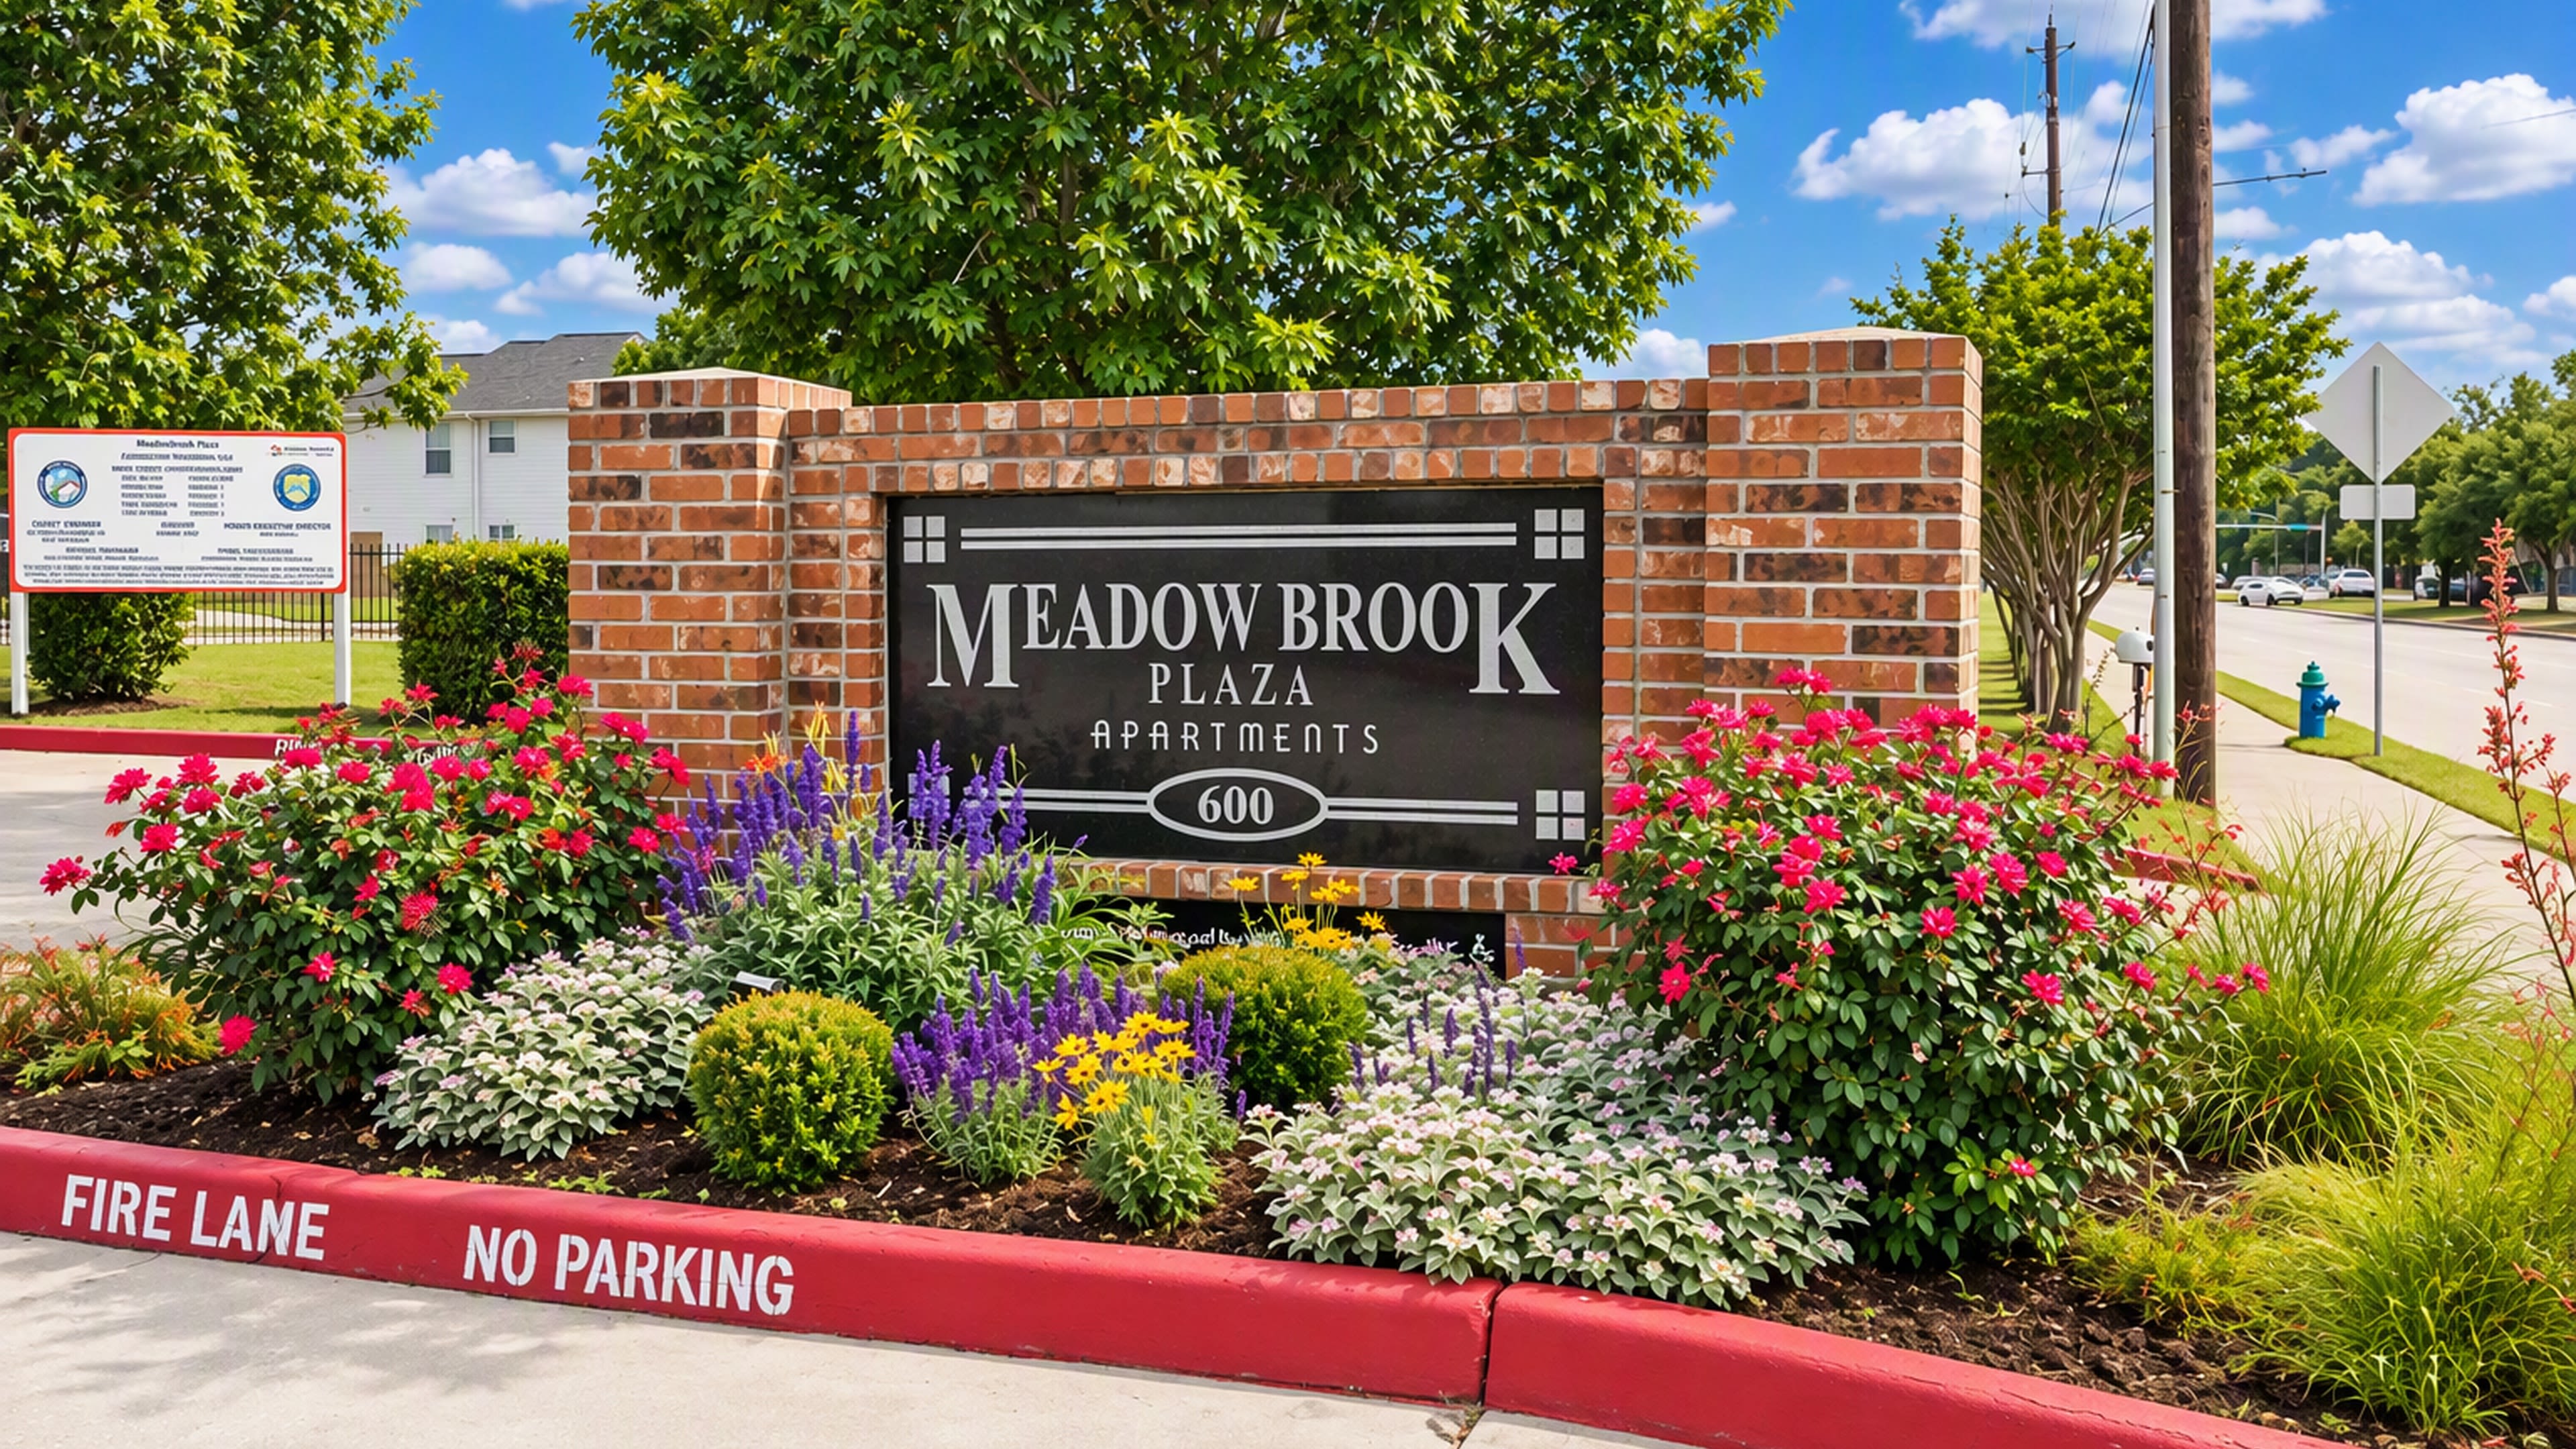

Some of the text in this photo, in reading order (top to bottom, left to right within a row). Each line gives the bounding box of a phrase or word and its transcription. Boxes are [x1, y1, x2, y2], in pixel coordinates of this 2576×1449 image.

[926, 582, 1560, 694] MEADOW BROOK
[1148, 663, 1313, 706] PLAZA
[1089, 719, 1379, 755] APARTMENTS
[1198, 785, 1274, 824] 600
[61, 1174, 329, 1260] FIRE LANE
[463, 1225, 794, 1316] NO PARKING
